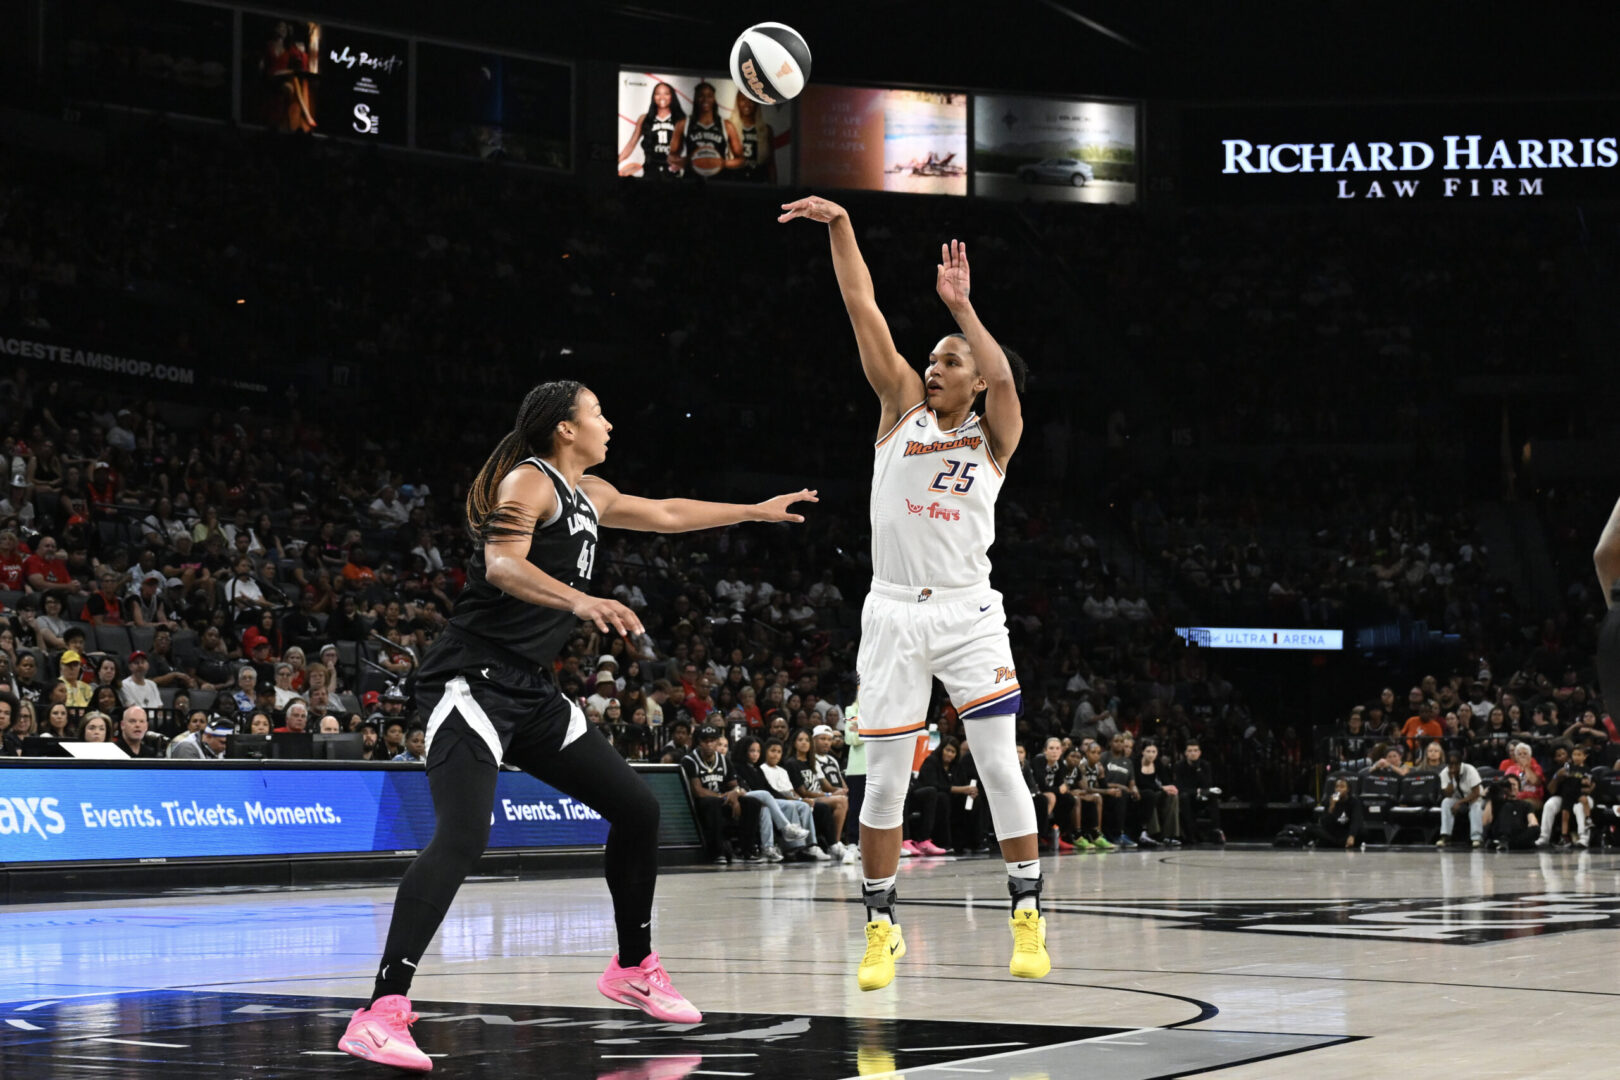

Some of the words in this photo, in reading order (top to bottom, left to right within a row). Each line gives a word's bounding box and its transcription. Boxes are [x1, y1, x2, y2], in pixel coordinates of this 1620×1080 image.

[330, 46, 356, 69] Why
[1222, 139, 1434, 173] RICHARD
[1443, 135, 1619, 170] HARRIS
[1337, 179, 1420, 199] LAW
[1443, 178, 1544, 197] FIRM
[903, 436, 983, 457] Mercury
[928, 458, 978, 496] 25
[576, 540, 596, 580] 41
[1225, 633, 1268, 644] ULTRA
[1283, 634, 1325, 645] ARENA
[80, 802, 162, 827] Events.
[161, 800, 244, 827] Tickets.
[244, 801, 342, 825] Moments.
[502, 799, 561, 821] Events.
